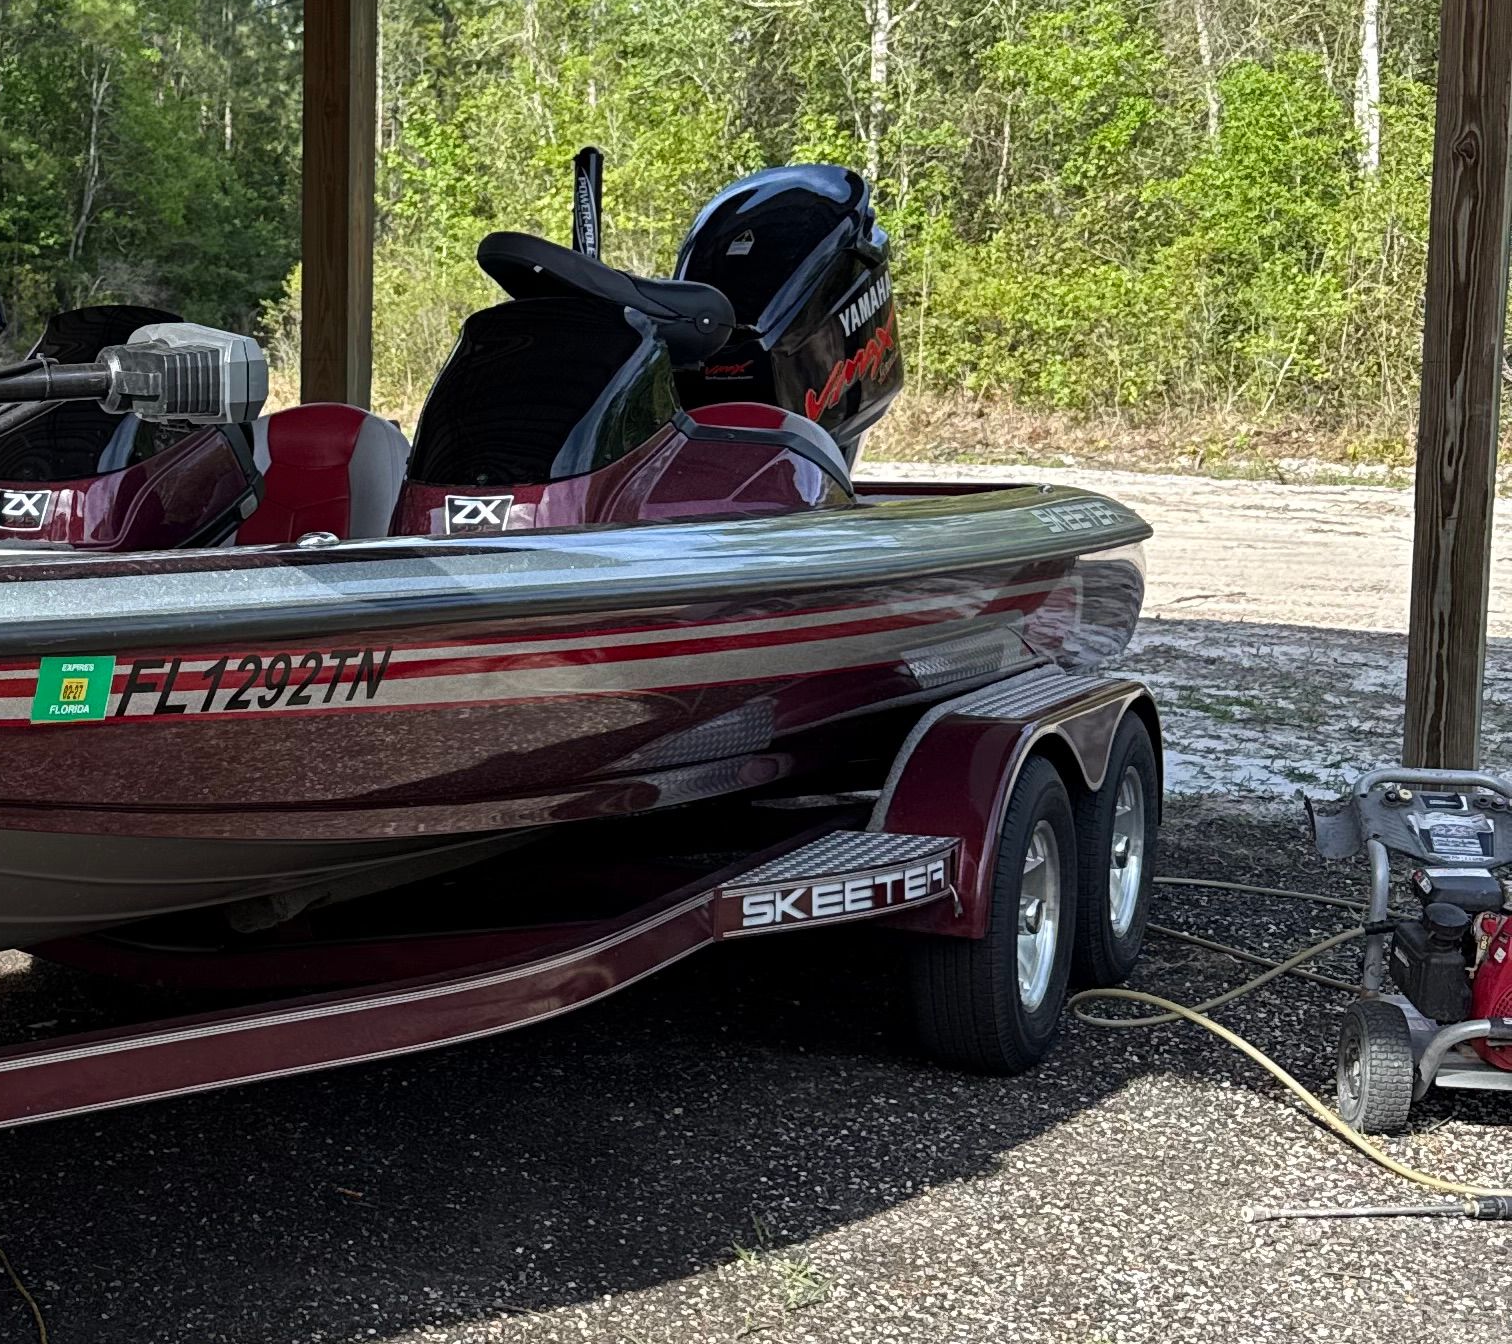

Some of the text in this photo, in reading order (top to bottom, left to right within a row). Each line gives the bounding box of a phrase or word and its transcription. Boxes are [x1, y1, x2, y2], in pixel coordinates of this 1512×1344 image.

[578, 176, 596, 257] POWER-POLE
[839, 270, 892, 337] YAMAHA
[1, 493, 42, 516] ZX
[451, 499, 502, 524] ZX
[1030, 501, 1123, 533] SKEETER
[61, 663, 94, 672] EXPIRES
[49, 704, 90, 715] FLORIDA
[742, 859, 945, 927] SKEETER
